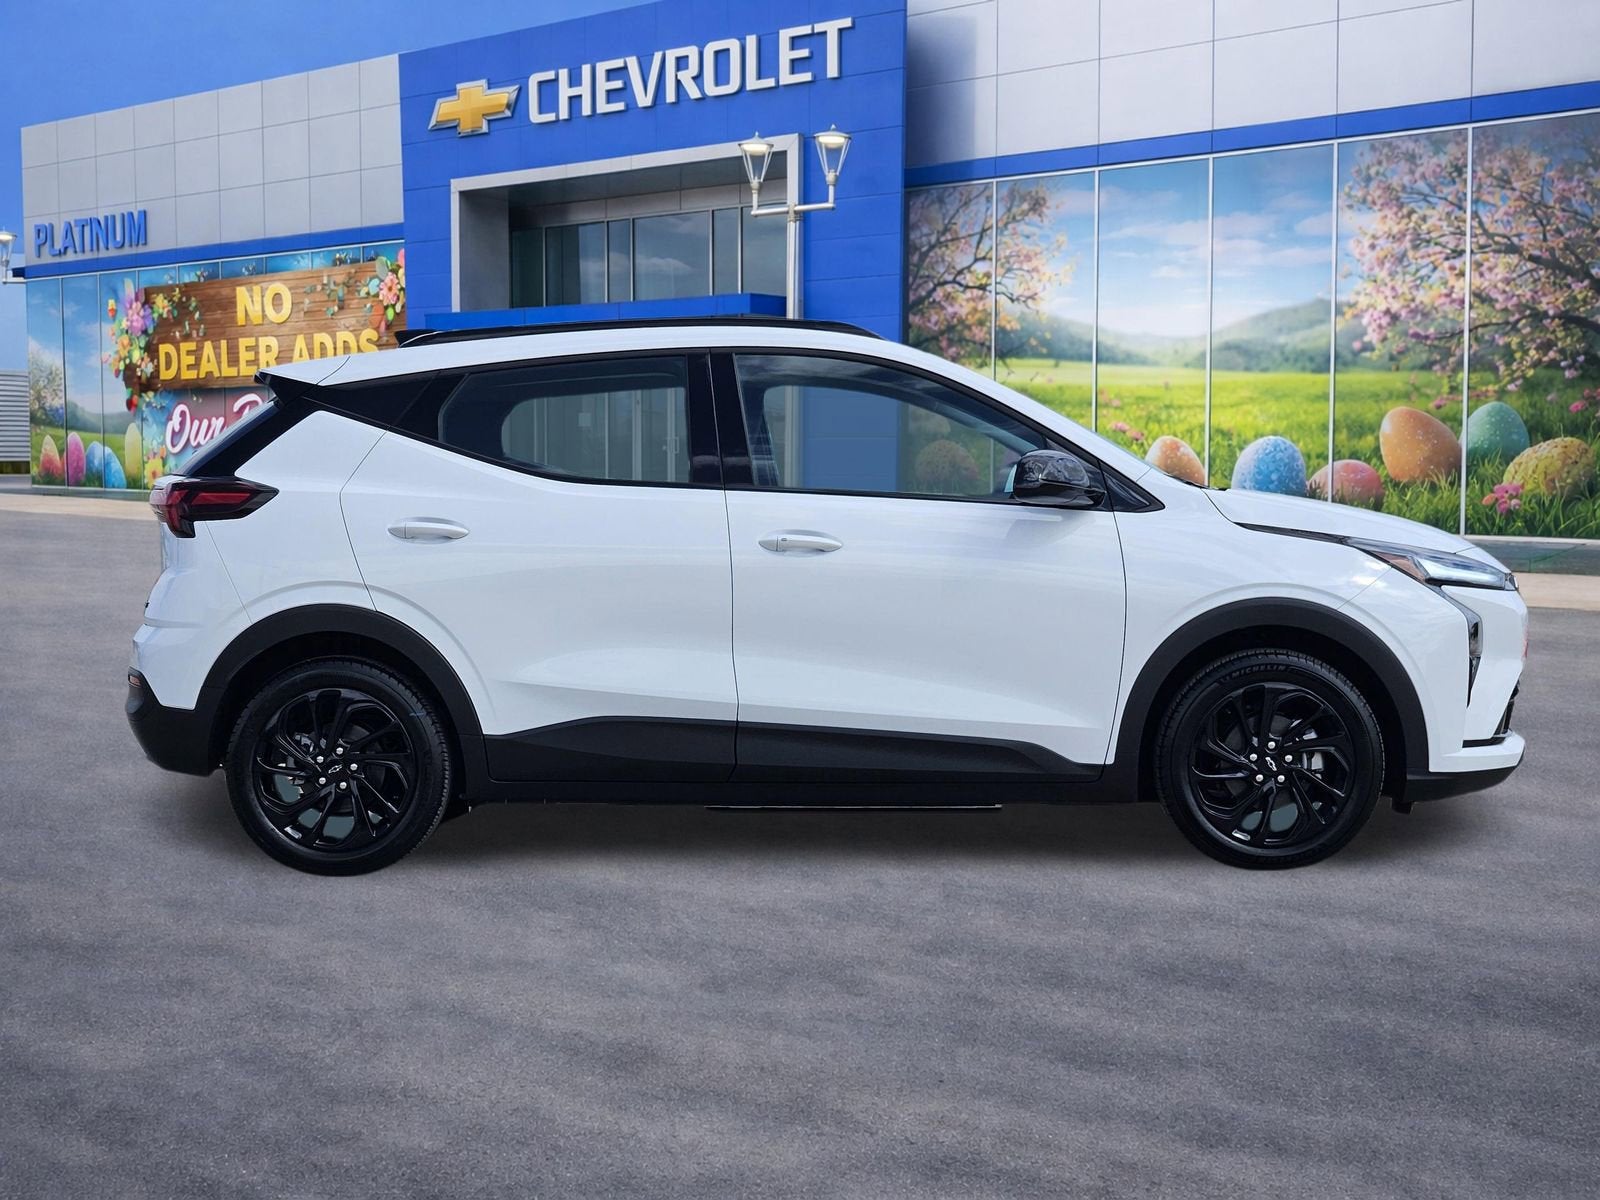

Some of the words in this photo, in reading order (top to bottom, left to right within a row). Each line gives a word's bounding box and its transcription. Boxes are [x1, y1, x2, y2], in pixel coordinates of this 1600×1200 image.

[528, 17, 854, 124] CHEVROLET
[34, 209, 148, 257] PLATINUM
[235, 283, 293, 326] NO
[158, 335, 280, 381] DEALER
